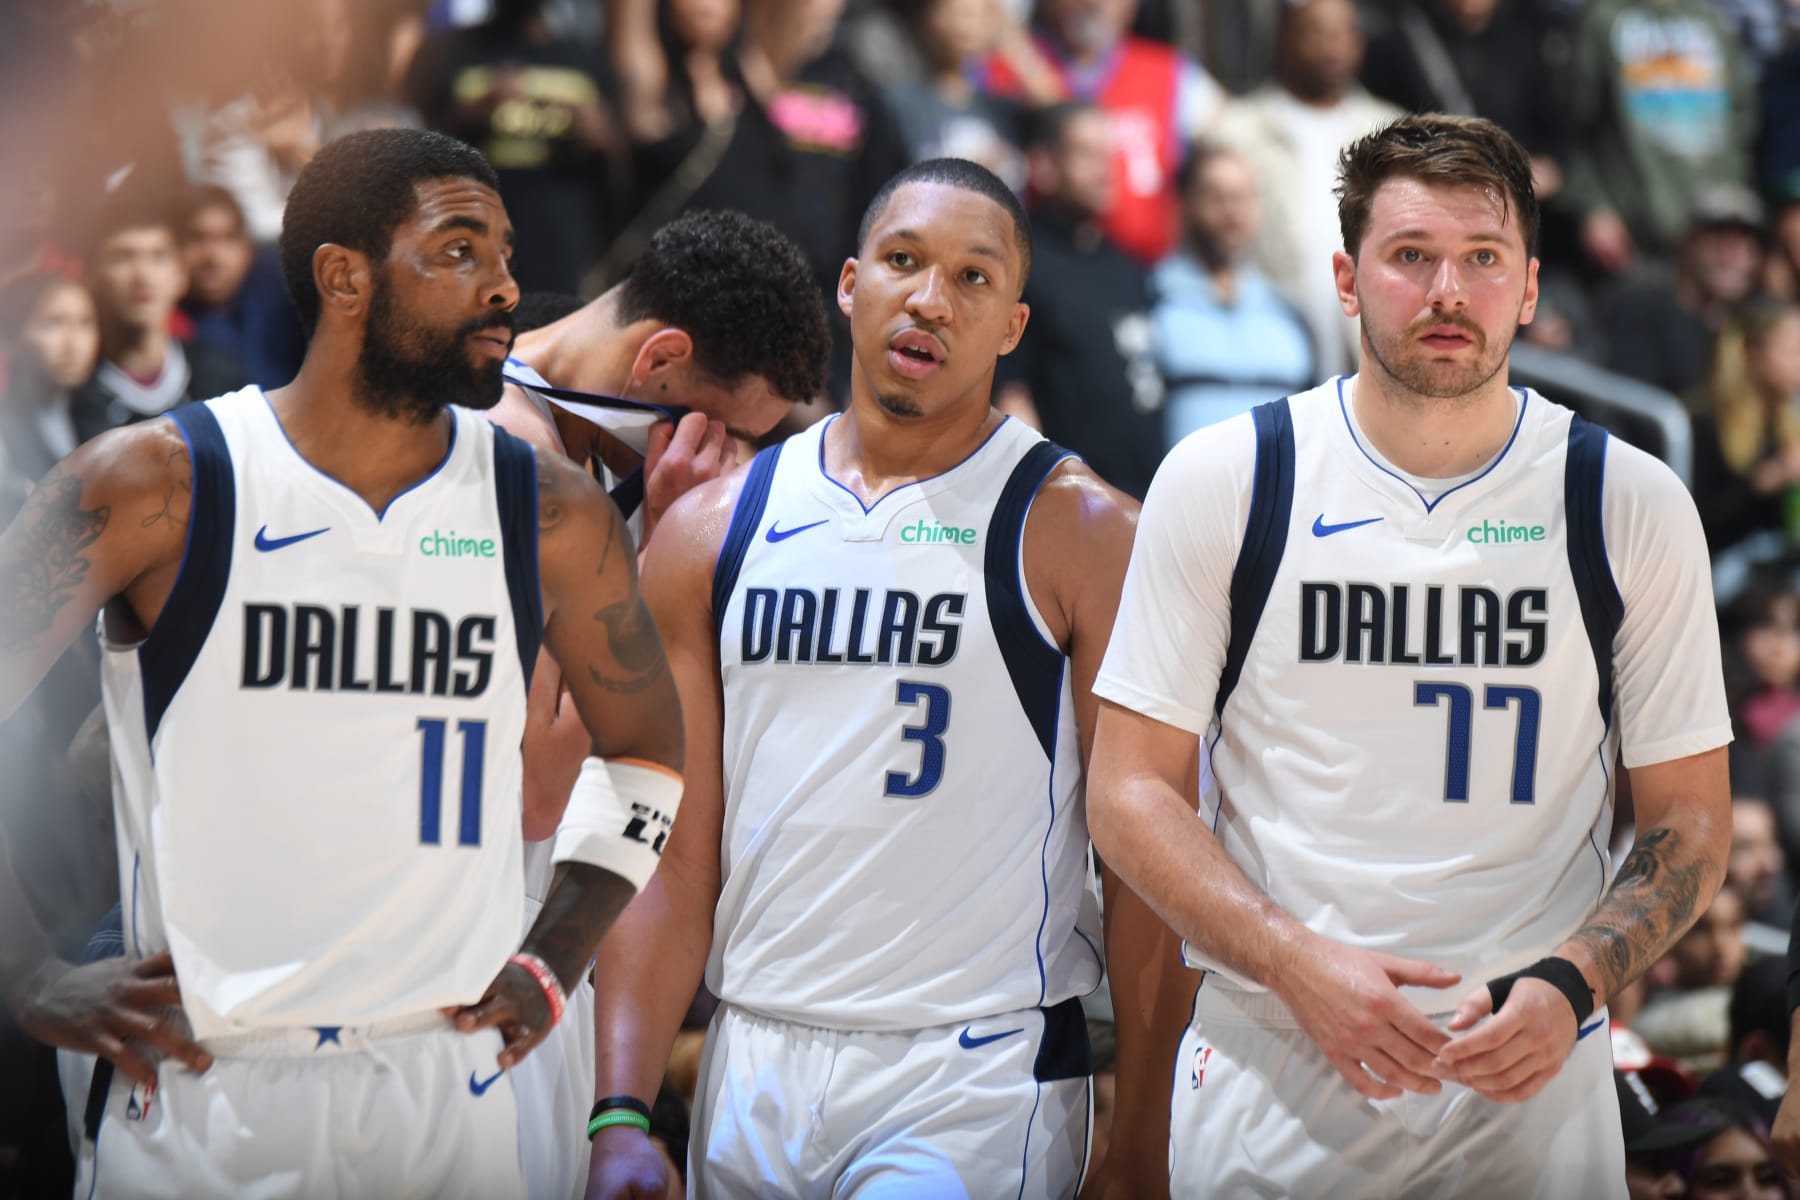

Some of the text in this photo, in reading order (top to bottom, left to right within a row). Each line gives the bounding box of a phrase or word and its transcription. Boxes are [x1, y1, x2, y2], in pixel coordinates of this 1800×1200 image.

[419, 529, 496, 558] chime
[899, 518, 977, 545] chime
[1466, 518, 1546, 544] chime
[238, 600, 497, 701] DALLAS
[740, 586, 968, 669] DALLAS
[1298, 580, 1549, 669] DALLAS
[415, 715, 489, 849] 11
[883, 678, 952, 800] 3
[1412, 679, 1543, 805] 77
